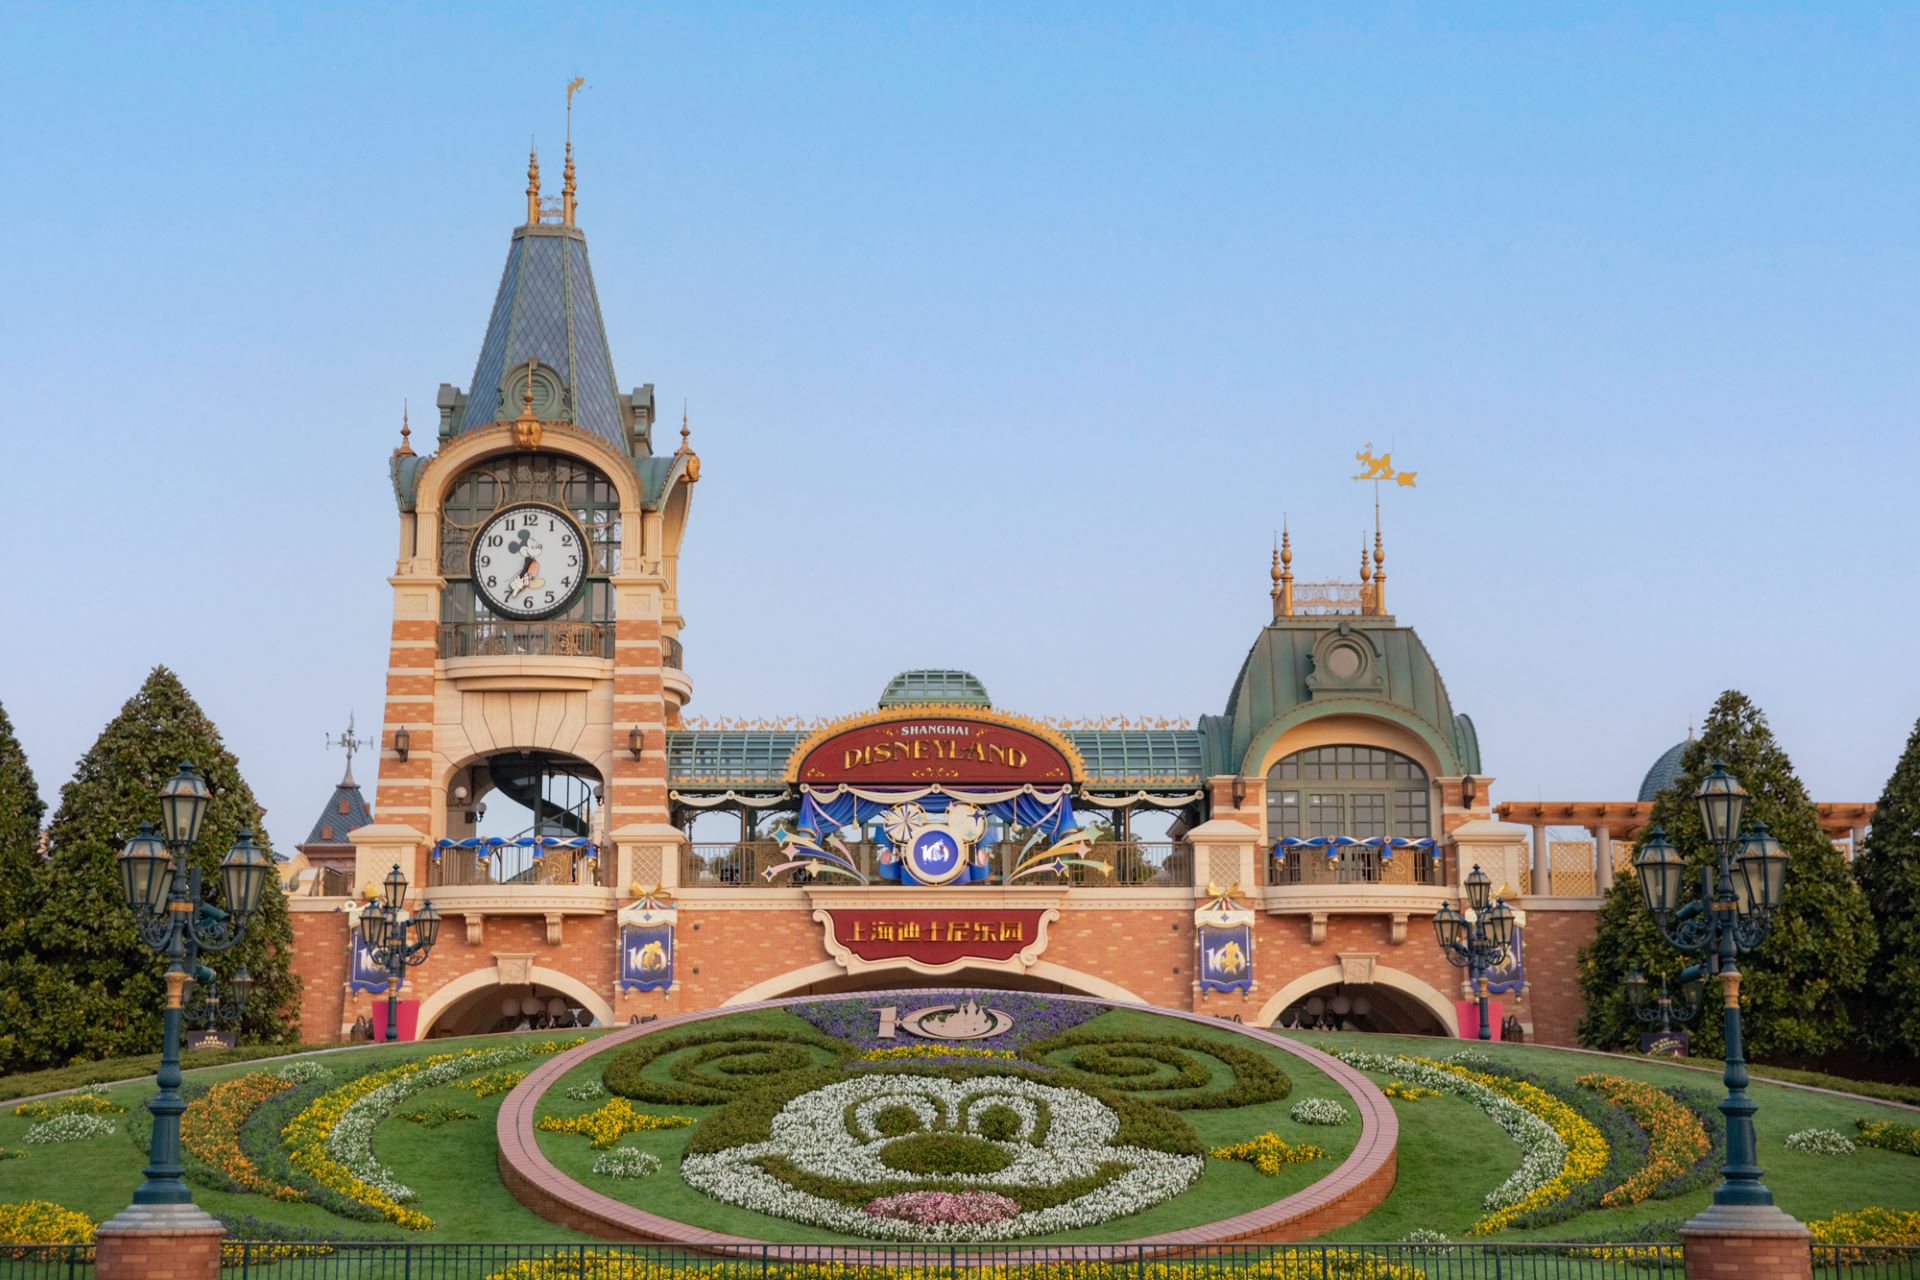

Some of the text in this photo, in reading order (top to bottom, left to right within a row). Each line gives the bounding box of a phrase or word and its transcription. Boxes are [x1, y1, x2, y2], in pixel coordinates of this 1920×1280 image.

[505, 519, 515, 531] 11
[523, 514, 538, 526] 12
[549, 520, 554, 532] 1
[487, 535, 503, 547] 10
[562, 535, 572, 547] 2
[481, 555, 490, 567] 9
[568, 555, 578, 567] 3
[487, 575, 497, 588] 8
[561, 576, 571, 588] 4
[504, 590, 513, 603] 7
[524, 596, 533, 609] 6
[544, 591, 555, 603] 5
[901, 725, 969, 736] SHANGHAI
[844, 740, 1028, 770] DISNEYLAND
[846, 921, 1024, 942] 上海迪士尼乐园
